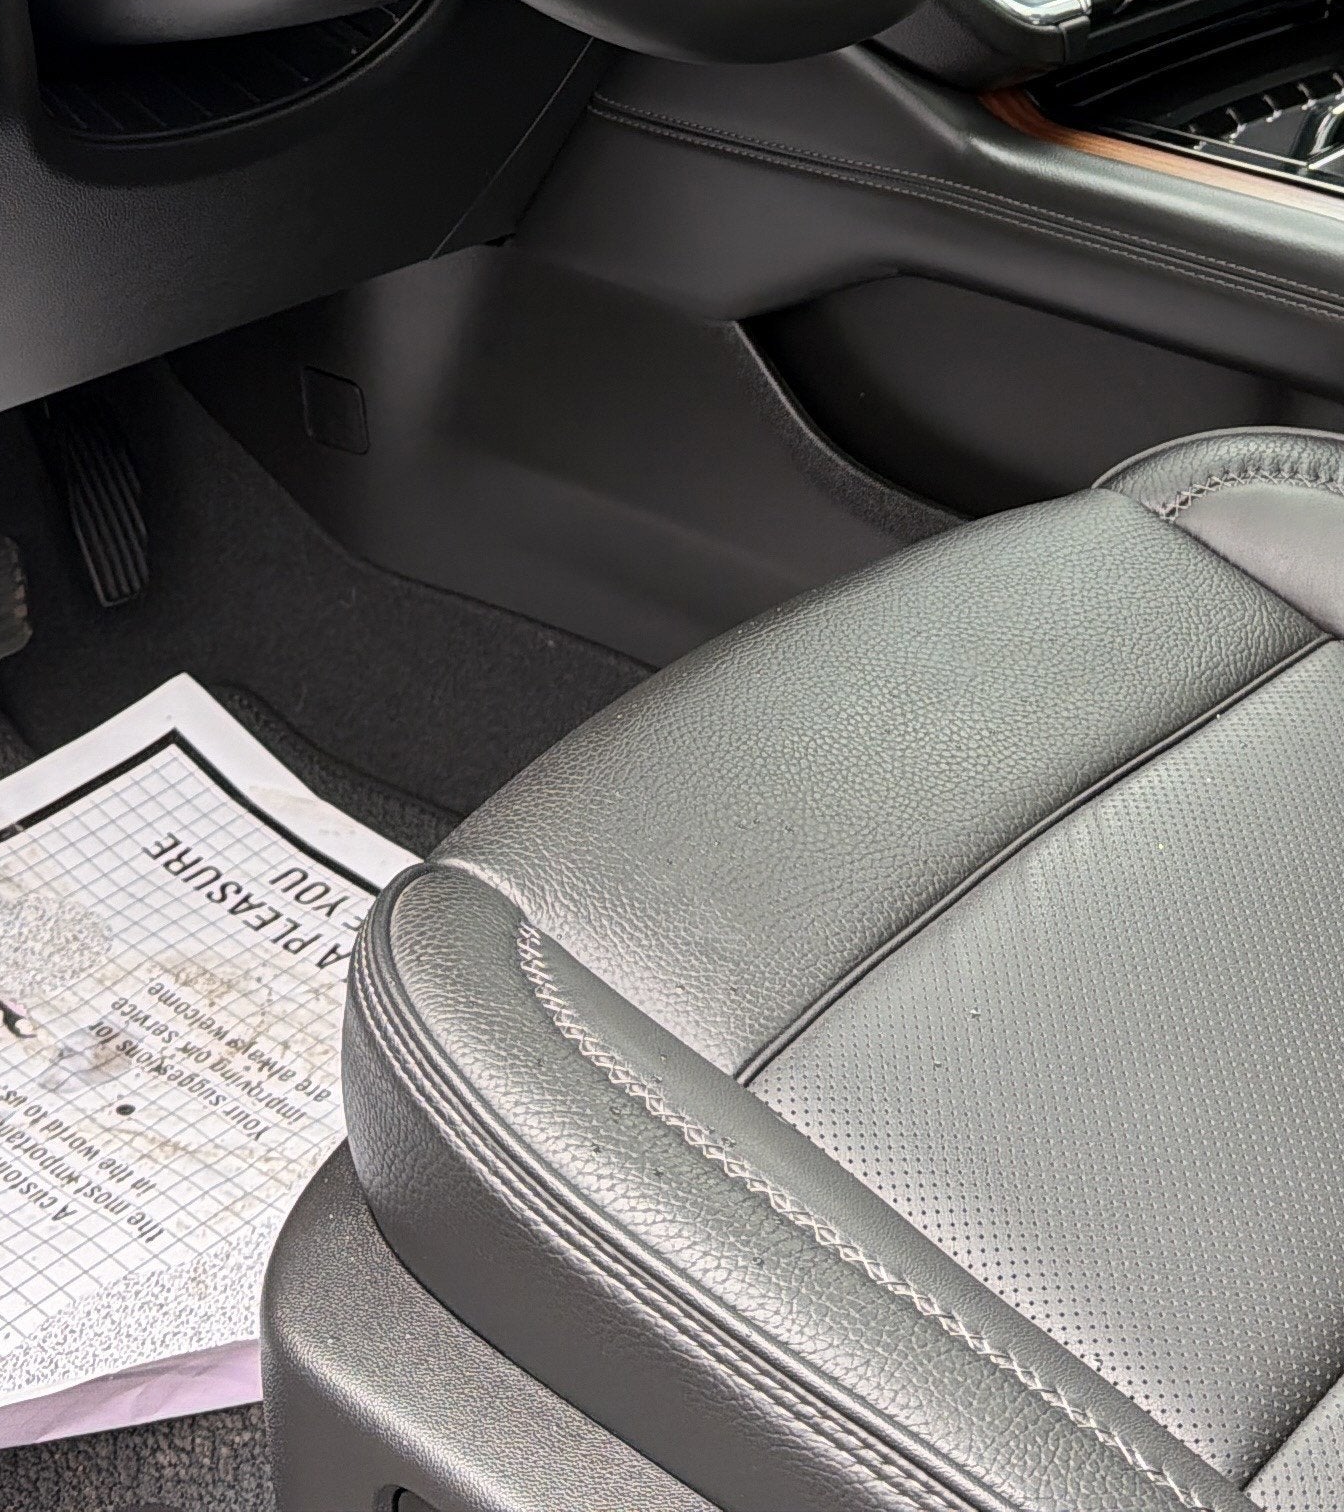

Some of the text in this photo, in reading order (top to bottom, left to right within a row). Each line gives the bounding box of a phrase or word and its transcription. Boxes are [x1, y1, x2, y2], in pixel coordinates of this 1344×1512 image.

[141, 831, 354, 969] A PLEASURE
[268, 867, 350, 917] YOU
[110, 996, 180, 1044] service
[147, 982, 331, 1103] are always welcome
[208, 1058, 306, 1125] improving
[23, 1104, 49, 1126] to
[40, 1119, 101, 1161] world
[98, 1157, 134, 1184] the
[130, 1176, 157, 1198] in
[51, 1203, 77, 1222] A
[73, 1180, 132, 1216] most
[126, 1211, 165, 1244] the
